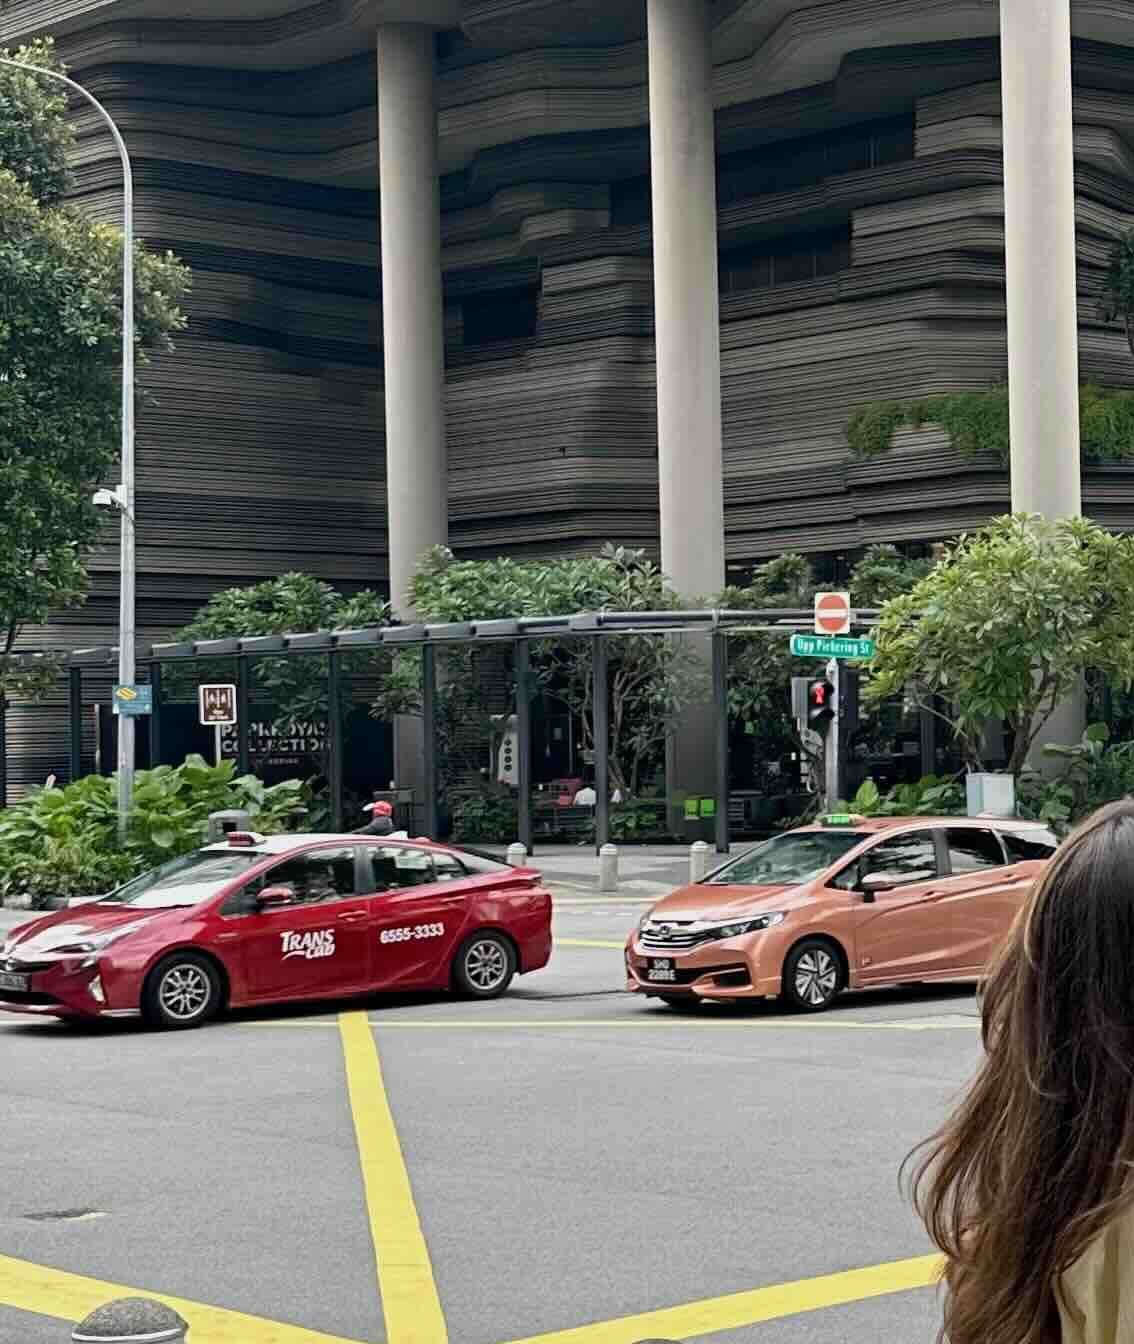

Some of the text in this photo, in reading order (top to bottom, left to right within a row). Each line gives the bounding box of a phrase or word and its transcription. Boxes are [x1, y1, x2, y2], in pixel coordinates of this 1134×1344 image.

[797, 639, 870, 656] Upp Pickering St
[380, 922, 445, 944] 6555-3333
